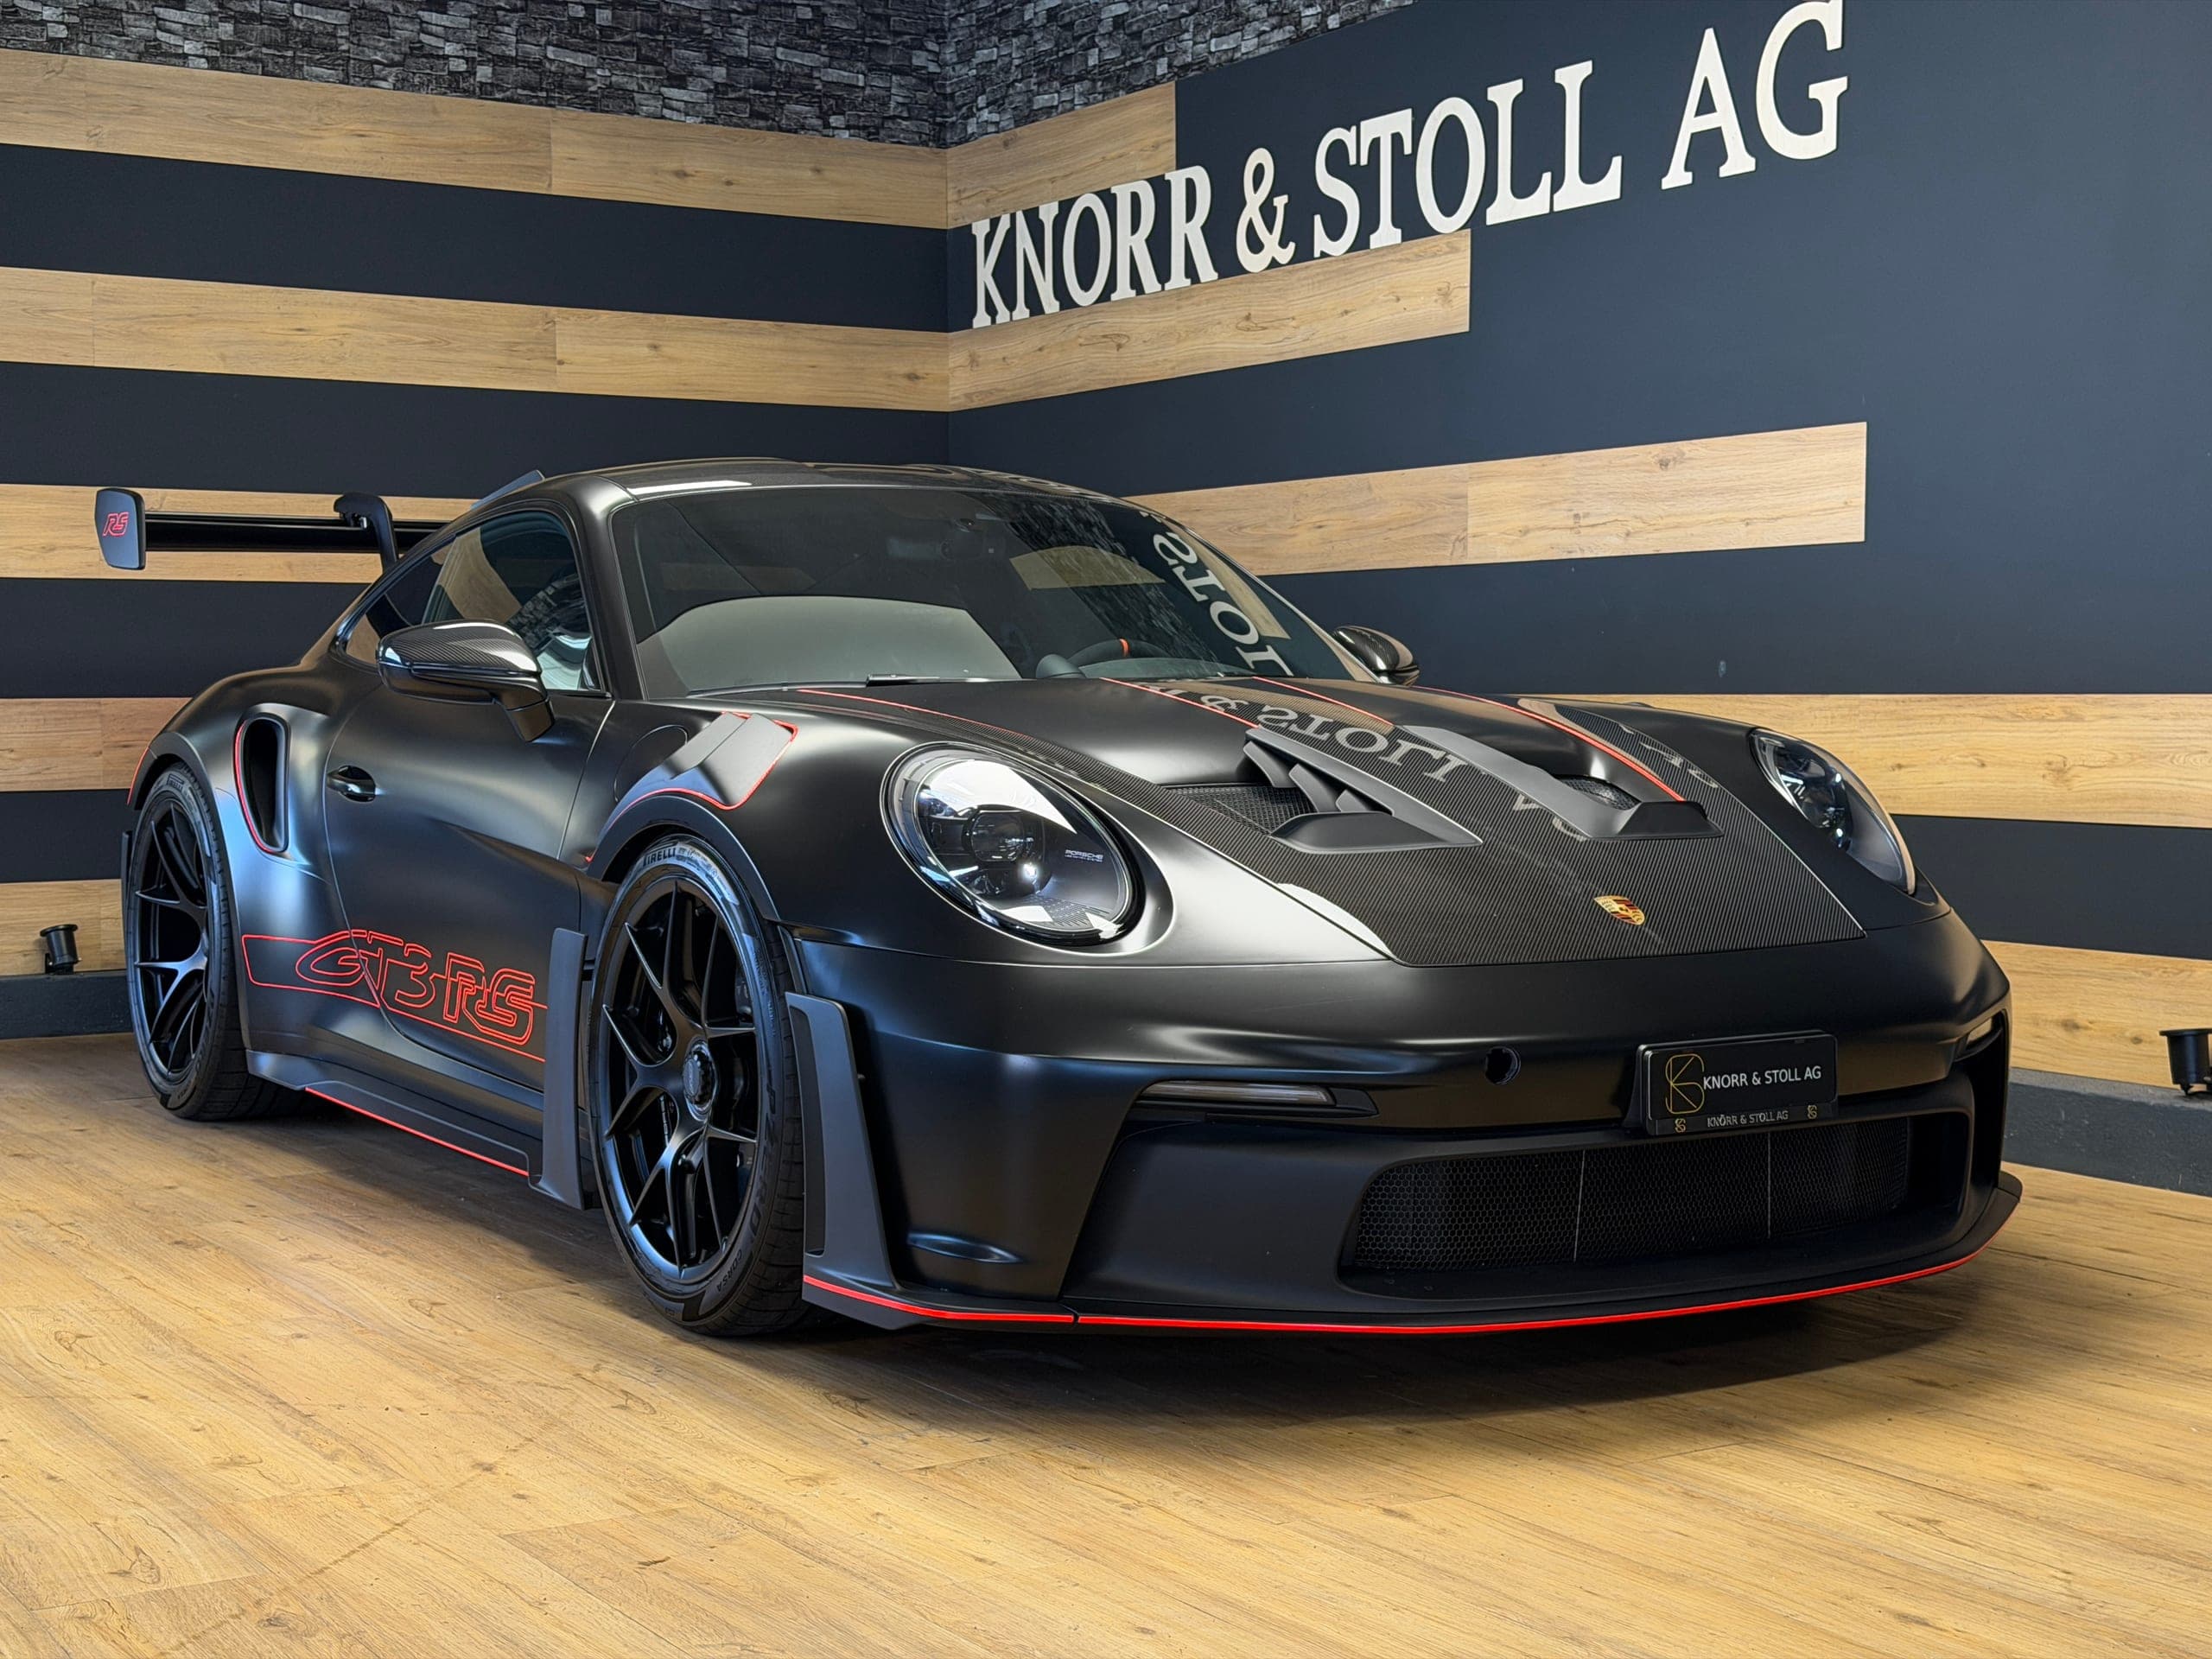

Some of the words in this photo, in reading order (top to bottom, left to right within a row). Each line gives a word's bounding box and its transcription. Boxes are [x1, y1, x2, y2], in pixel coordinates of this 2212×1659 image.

[972, 165, 1218, 329] KNORR
[1236, 148, 1296, 273] &
[1313, 60, 1623, 258] STOLL
[1661, 0, 1848, 190] AG
[1703, 1073, 1749, 1090] KNORR
[1751, 1071, 1762, 1085] &
[1764, 1069, 1802, 1084] STOLL
[1804, 1065, 1821, 1080] AG
[1749, 1112, 1776, 1123] STOLL
[1777, 1110, 1789, 1121] AG
